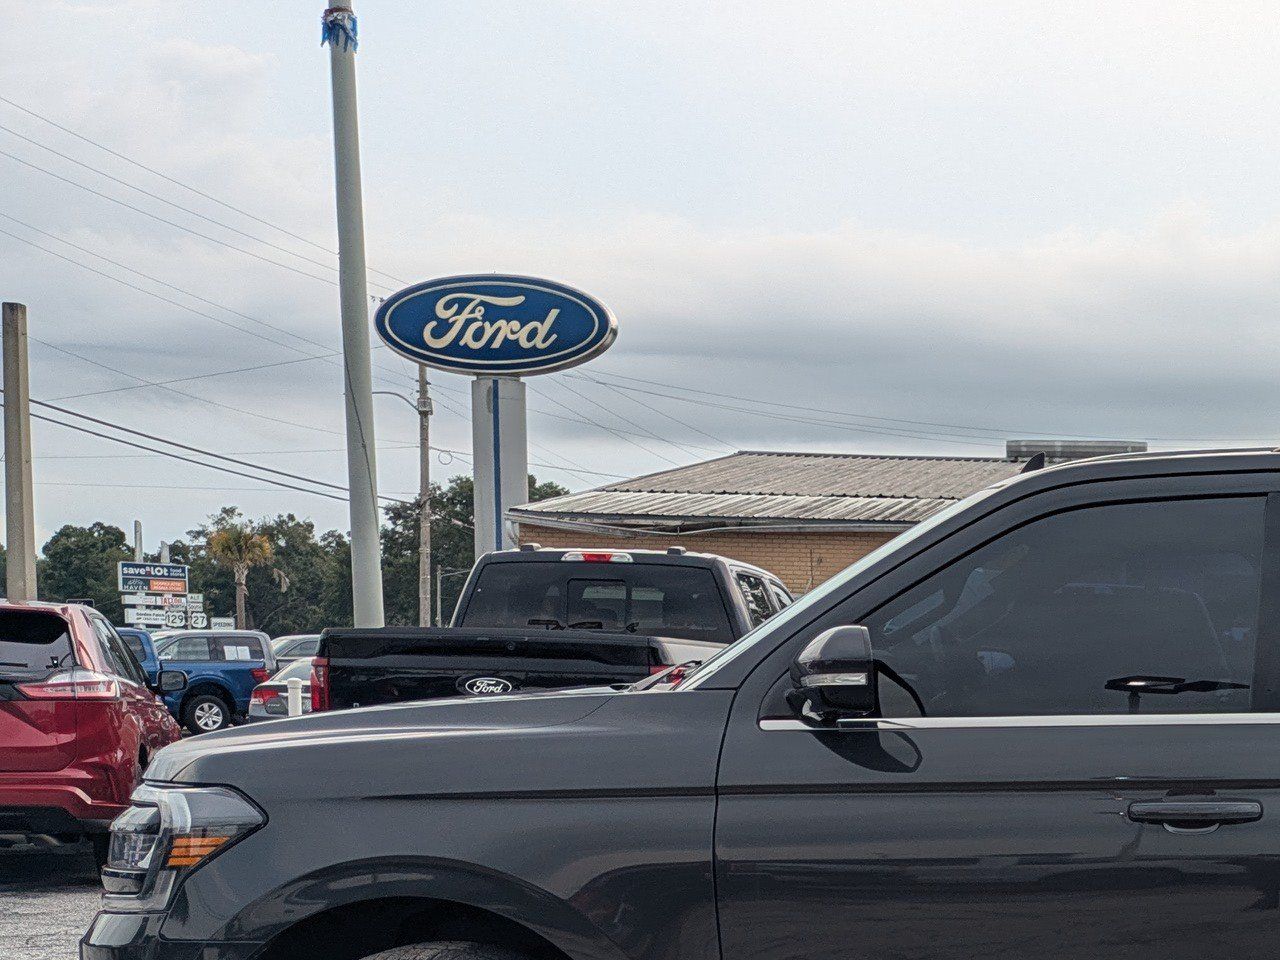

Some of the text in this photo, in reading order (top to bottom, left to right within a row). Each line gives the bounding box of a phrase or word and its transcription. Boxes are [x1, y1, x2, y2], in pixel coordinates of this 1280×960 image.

[423, 293, 560, 349] Ford
[122, 566, 145, 575] save
[167, 614, 184, 624] 129
[193, 616, 205, 625] 27
[473, 680, 504, 693] Ford
